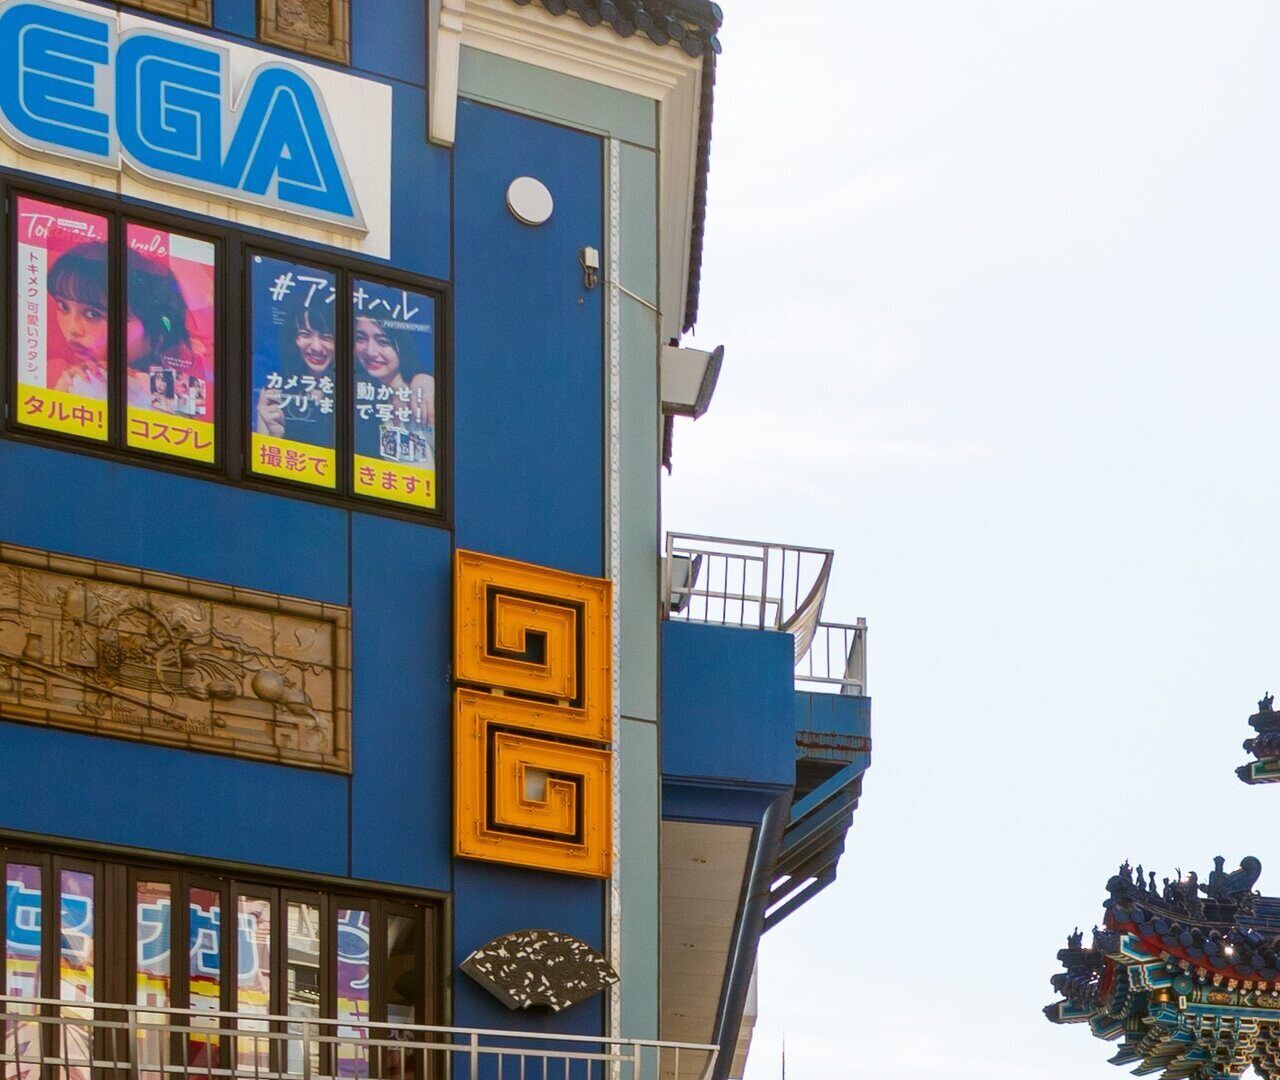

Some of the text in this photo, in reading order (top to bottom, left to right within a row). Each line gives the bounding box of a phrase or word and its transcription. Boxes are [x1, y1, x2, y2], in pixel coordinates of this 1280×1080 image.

[28, 252, 39, 298] トキメク
[24, 395, 432, 498] タル中! コスプレ 撮影で きます!
